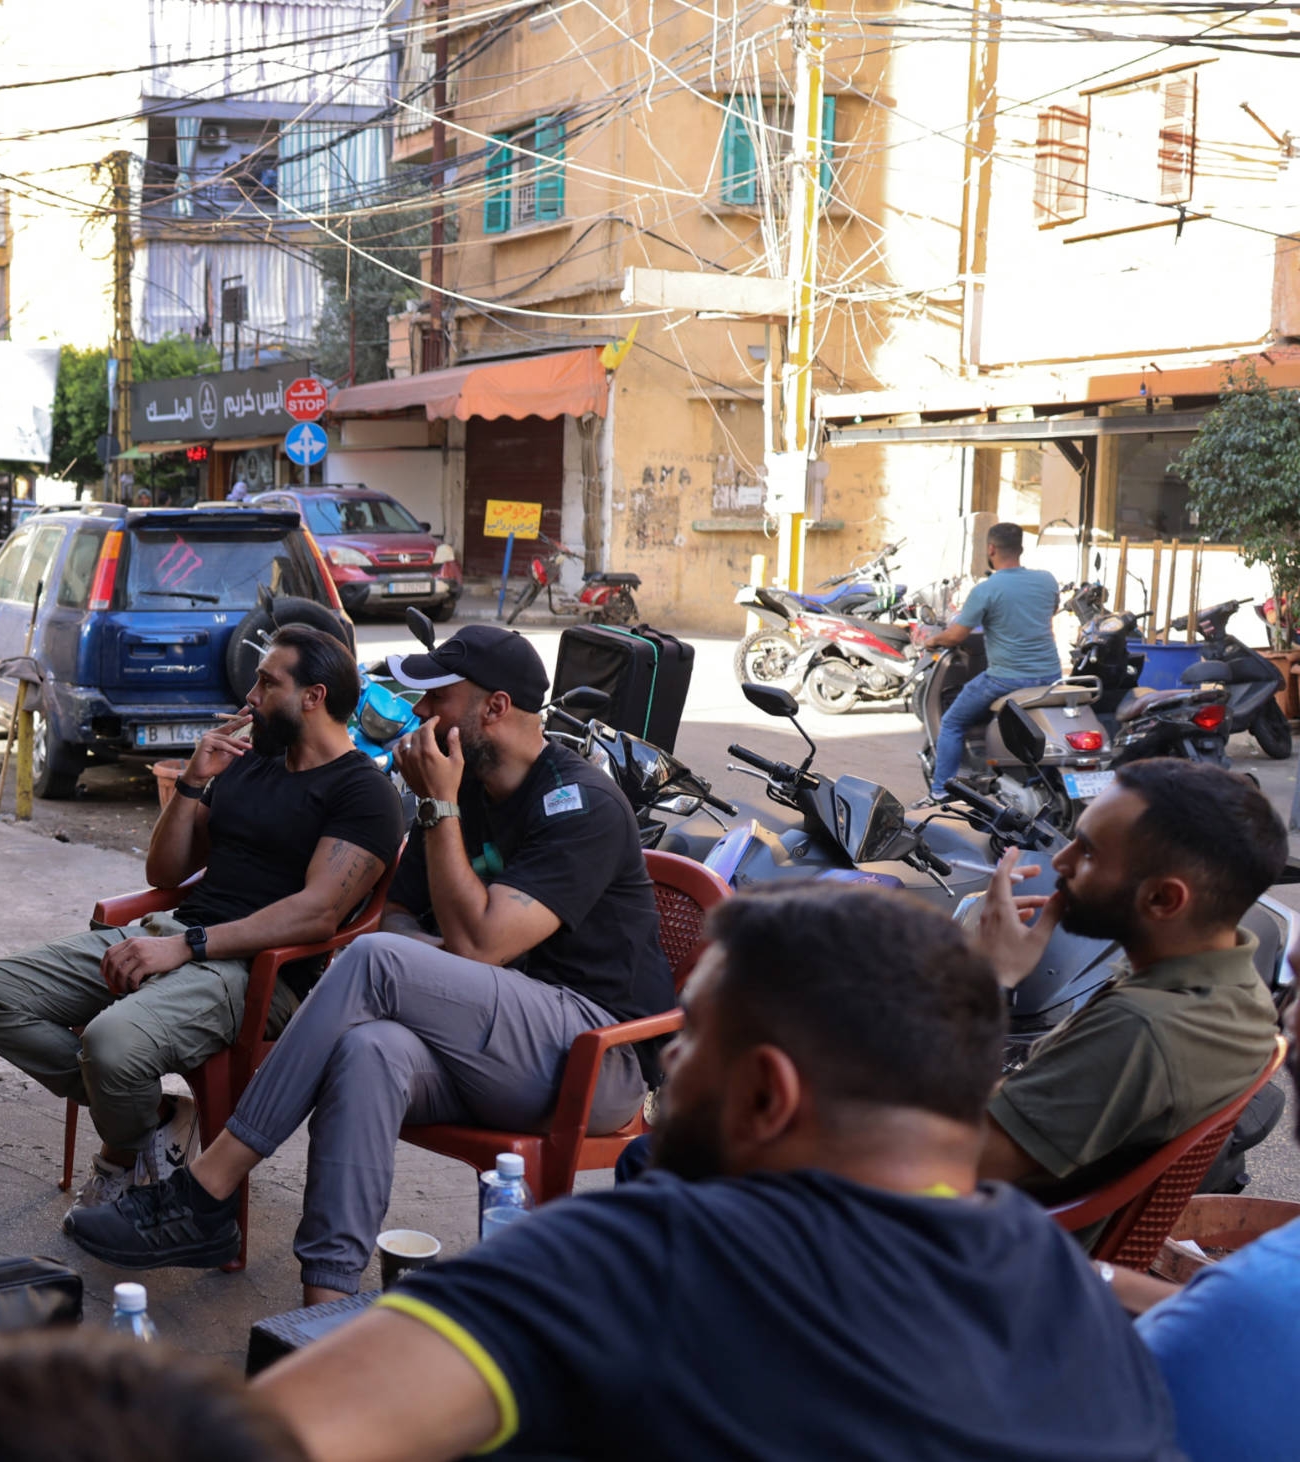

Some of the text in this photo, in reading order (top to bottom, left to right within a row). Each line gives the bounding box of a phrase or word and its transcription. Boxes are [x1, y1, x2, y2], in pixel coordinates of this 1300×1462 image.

[290, 382, 323, 397] قف
[145, 396, 194, 422] الملك
[223, 388, 255, 419] كريم
[288, 399, 325, 411] STOP
[149, 726, 158, 742] B
